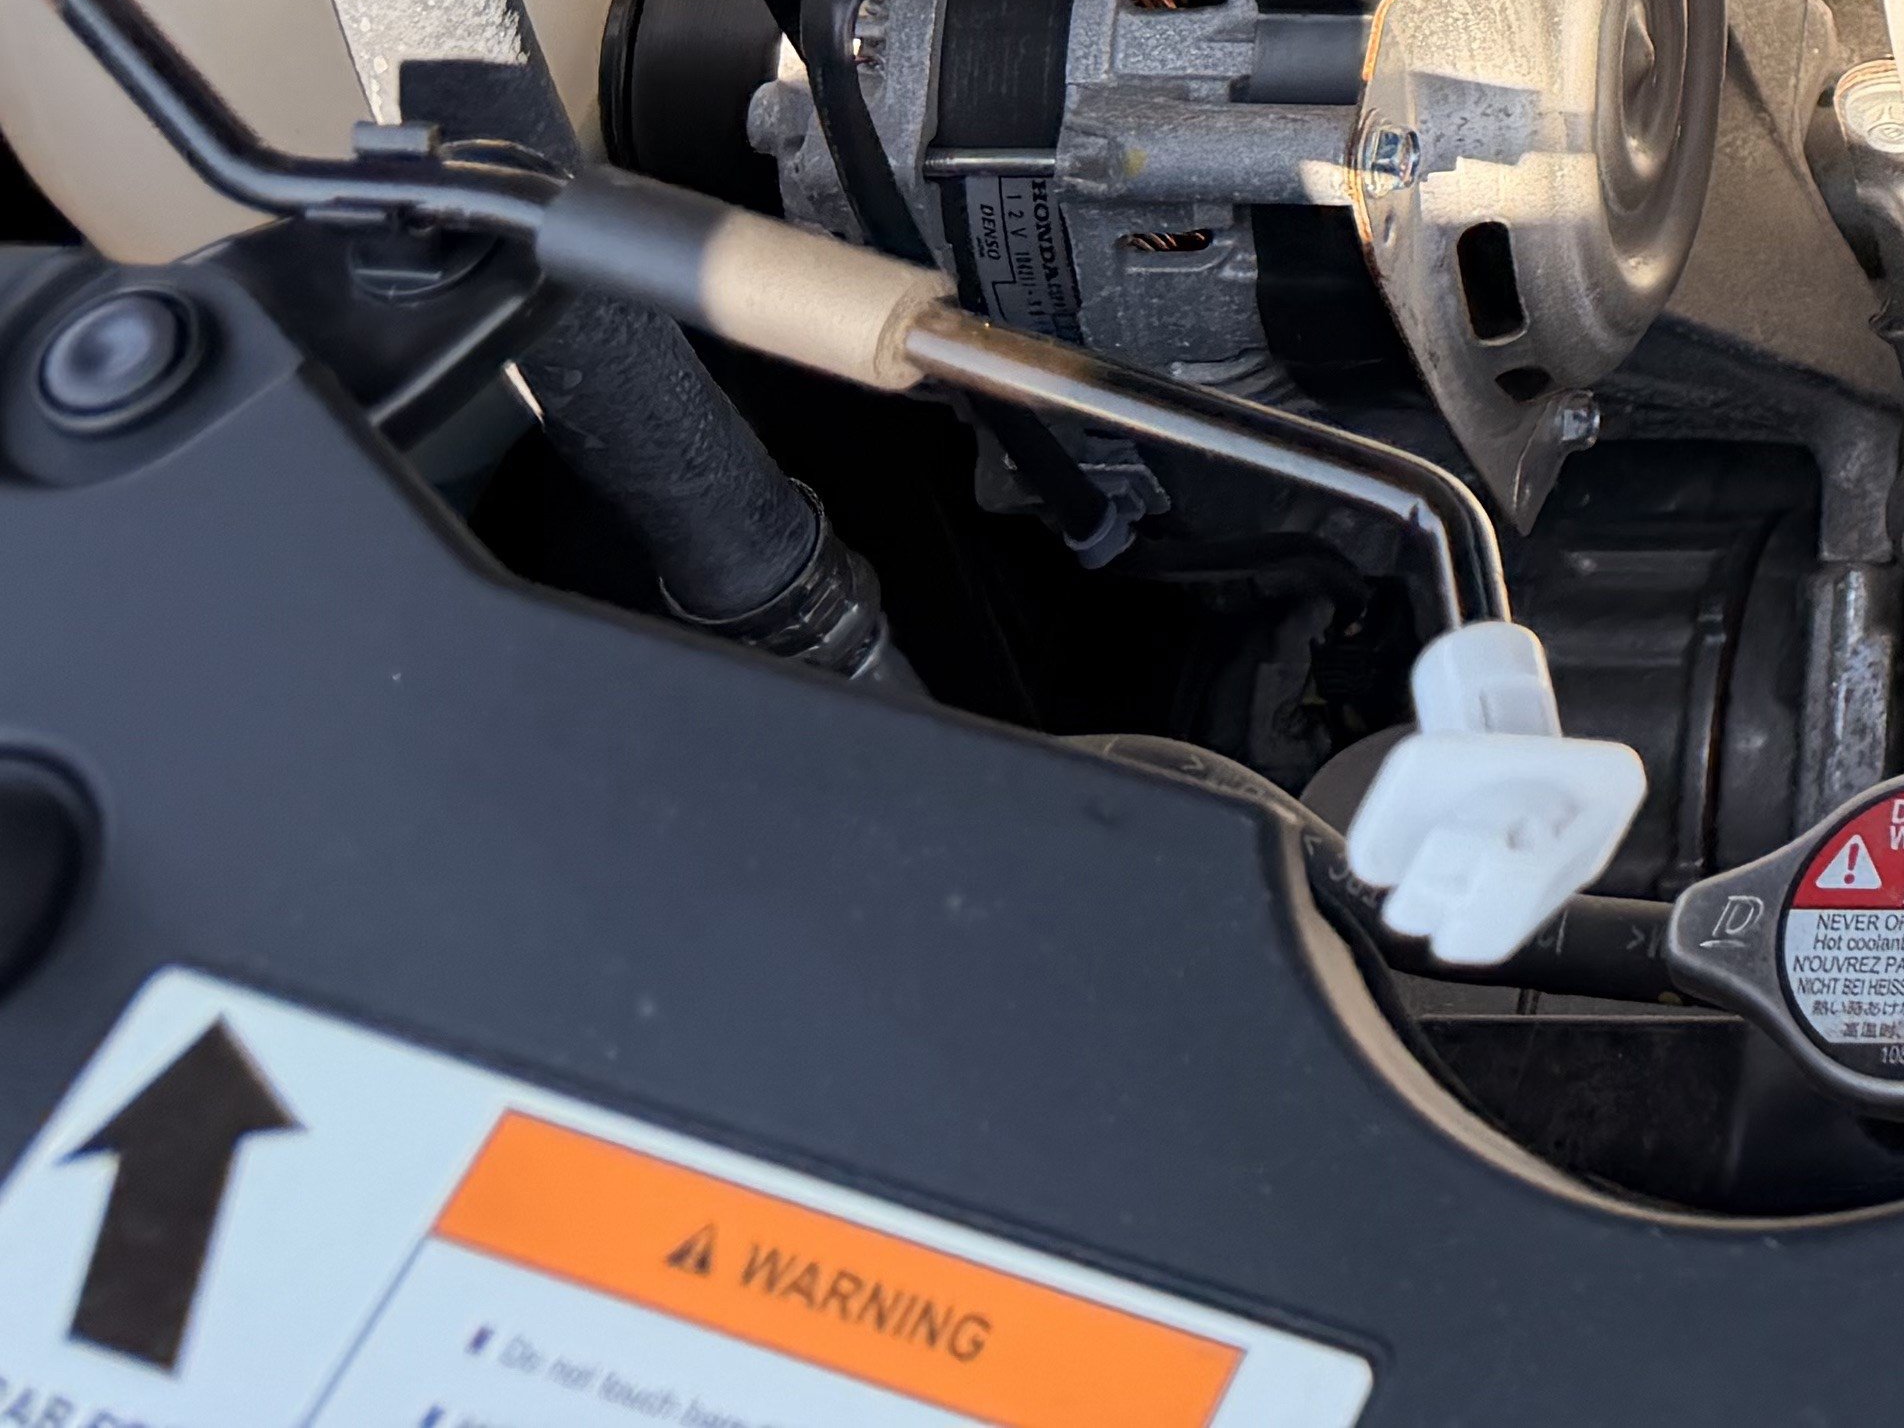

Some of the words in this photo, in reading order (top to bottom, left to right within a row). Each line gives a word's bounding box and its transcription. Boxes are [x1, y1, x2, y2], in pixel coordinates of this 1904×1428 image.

[980, 204, 1001, 261] DENSO
[1031, 179, 1059, 282] HONDA
[1817, 913, 1880, 931] NEVER
[1813, 933, 1843, 952] Hot
[1793, 955, 1881, 974] N'OUVREZ
[1797, 977, 1838, 995] NICHT
[1842, 978, 1865, 996] BEI
[740, 1244, 992, 1362] WARNING
